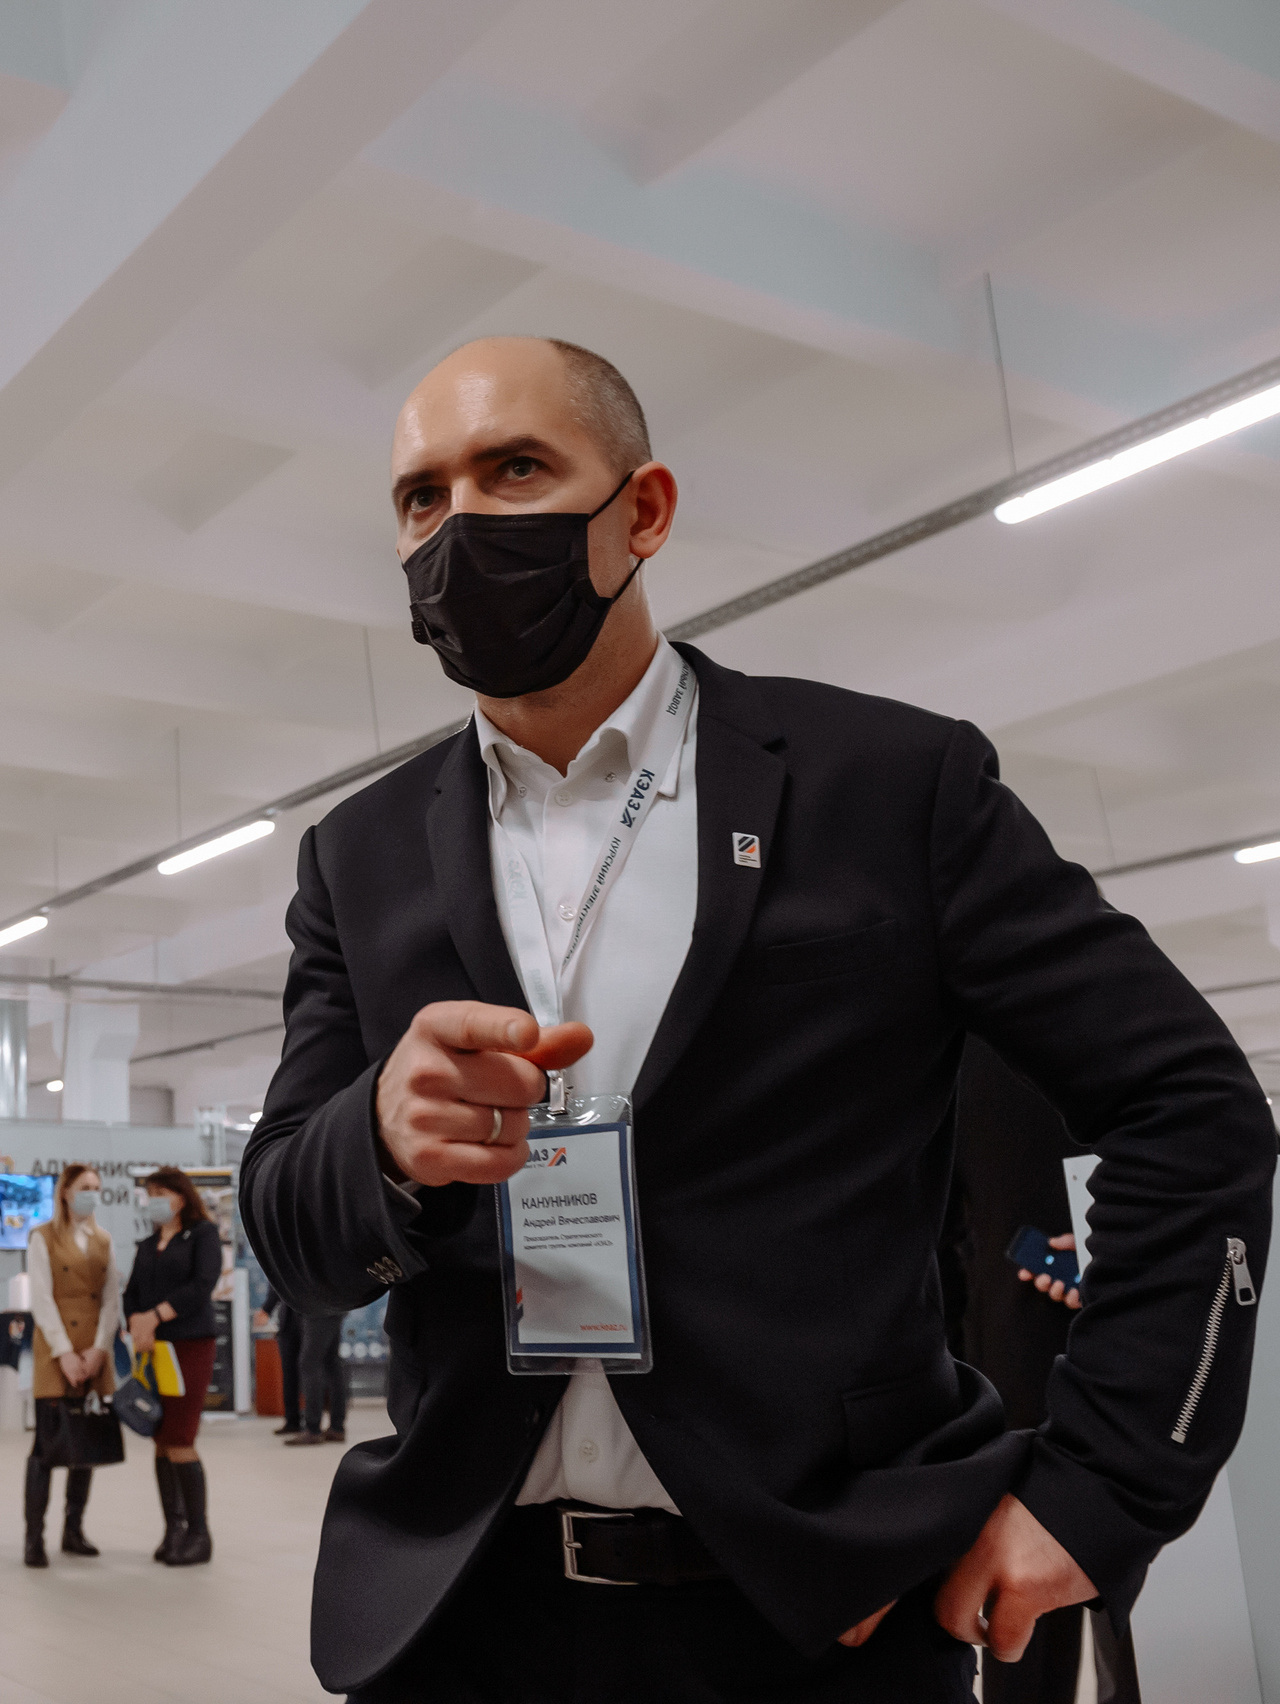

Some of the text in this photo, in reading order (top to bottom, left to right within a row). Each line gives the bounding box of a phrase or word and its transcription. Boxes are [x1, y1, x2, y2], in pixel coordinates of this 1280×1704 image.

[665, 687, 684, 716] ЗАВОД
[627, 768, 656, 811] КЭАЗ
[596, 836, 622, 886] КУРСКИЙ
[521, 1192, 598, 1210] КАНУННИКОВ
[523, 1214, 620, 1229] Андрей Вячеславович
